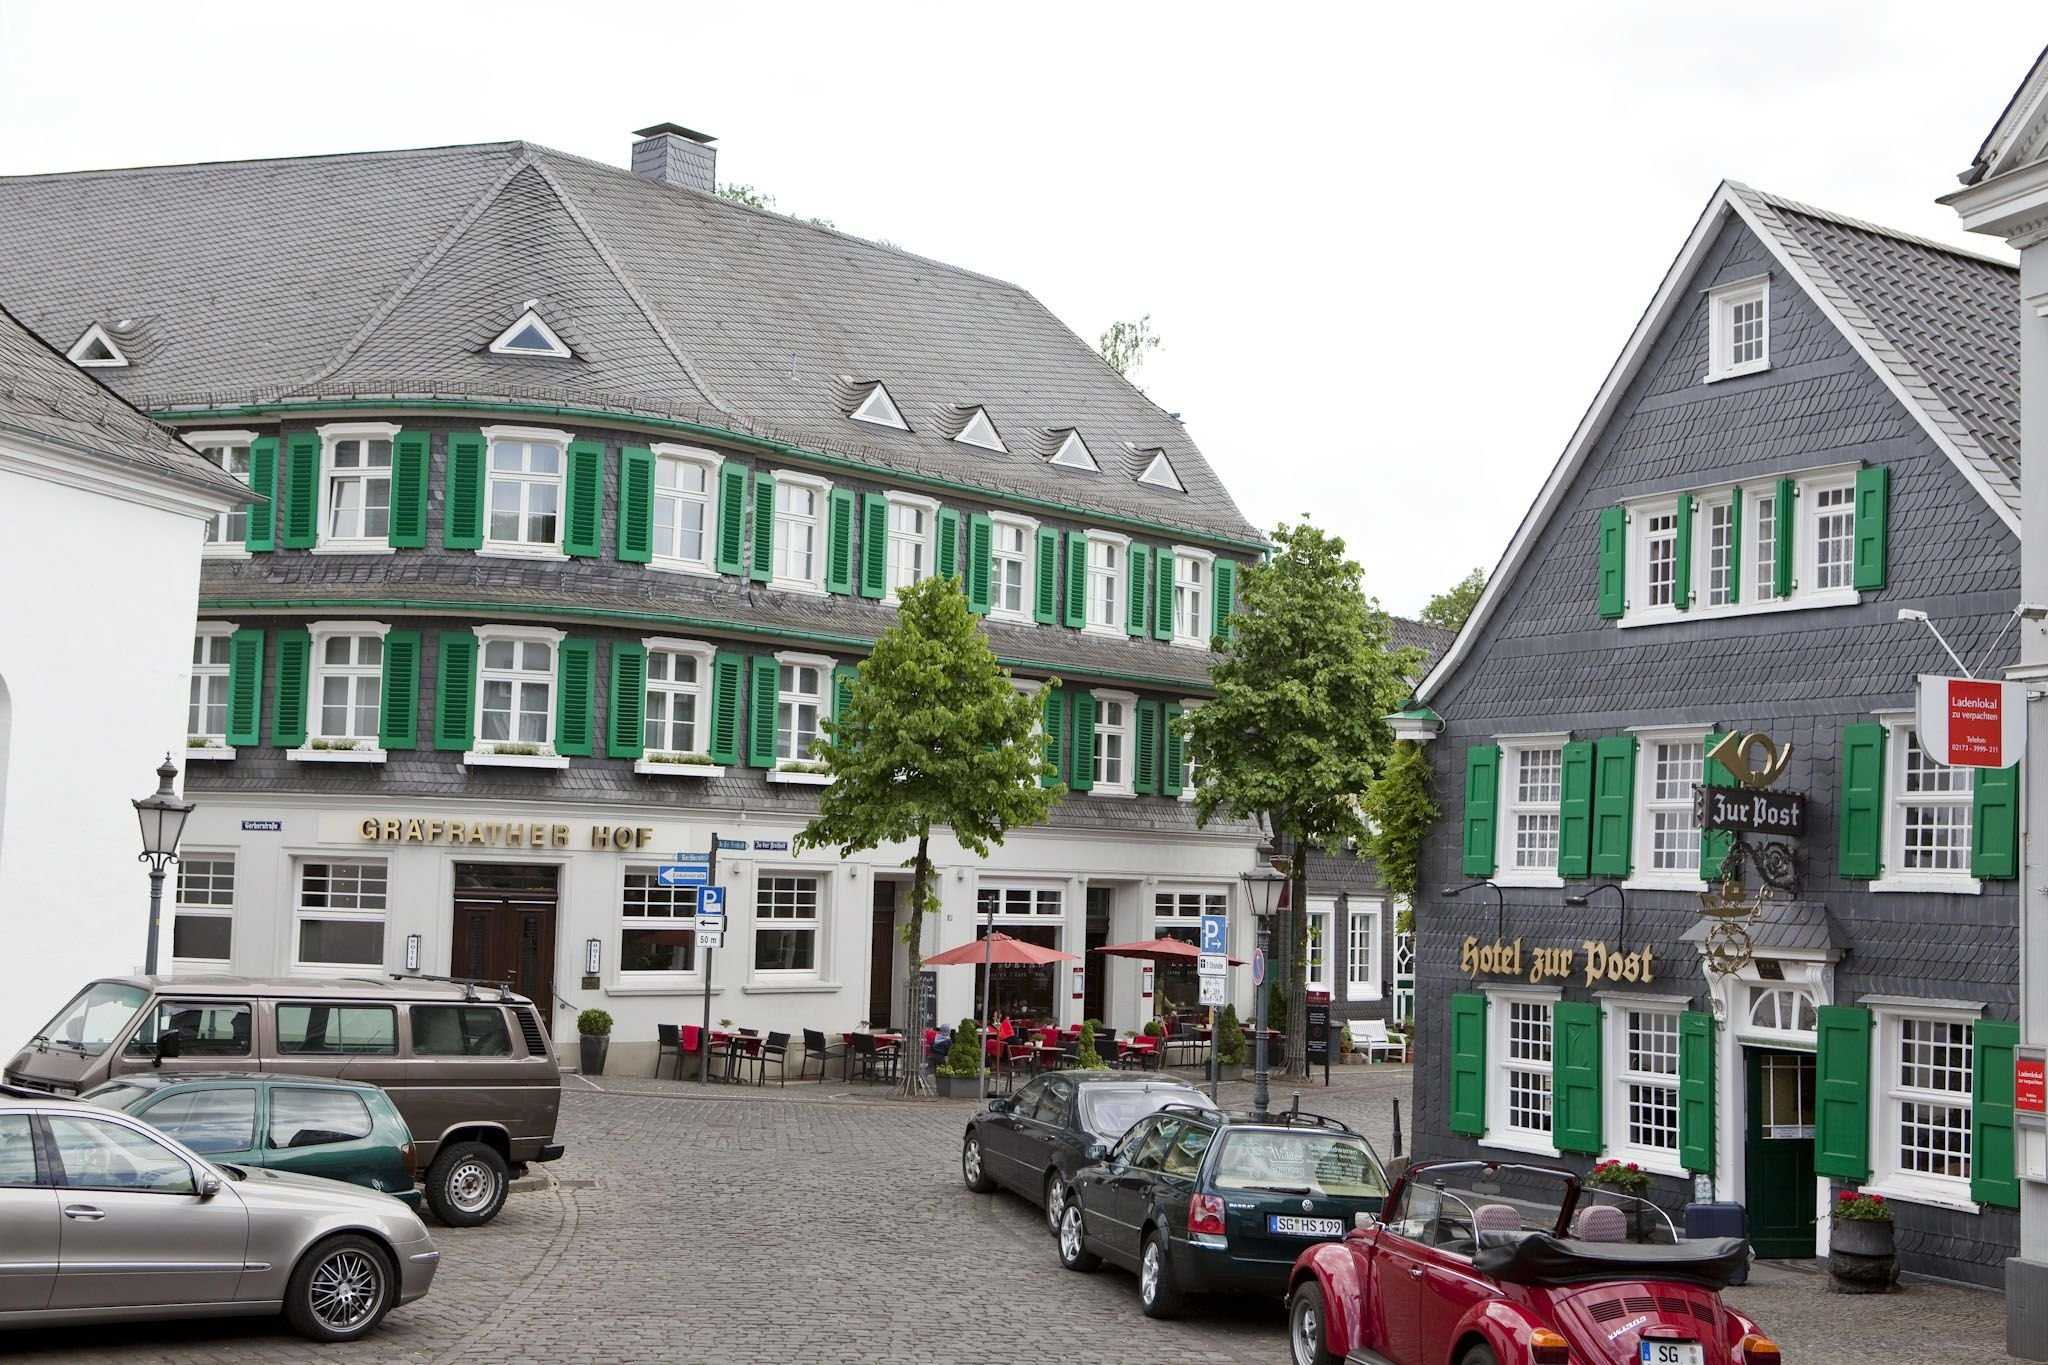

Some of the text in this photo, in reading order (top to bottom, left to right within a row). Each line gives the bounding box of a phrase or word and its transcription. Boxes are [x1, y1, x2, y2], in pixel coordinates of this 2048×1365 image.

[1952, 696, 1998, 709] Ladenlokal
[1952, 711, 1998, 721] zu verpachten
[1713, 793, 1800, 828] Zur Post
[360, 817, 654, 849] GRÄFRATHER HOF
[700, 935, 709, 944] 50
[1205, 920, 1219, 949] P
[1460, 935, 1655, 988] Hotel zur Post
[1278, 1218, 1342, 1234] SG HS 199
[1658, 1345, 1679, 1363] SG
